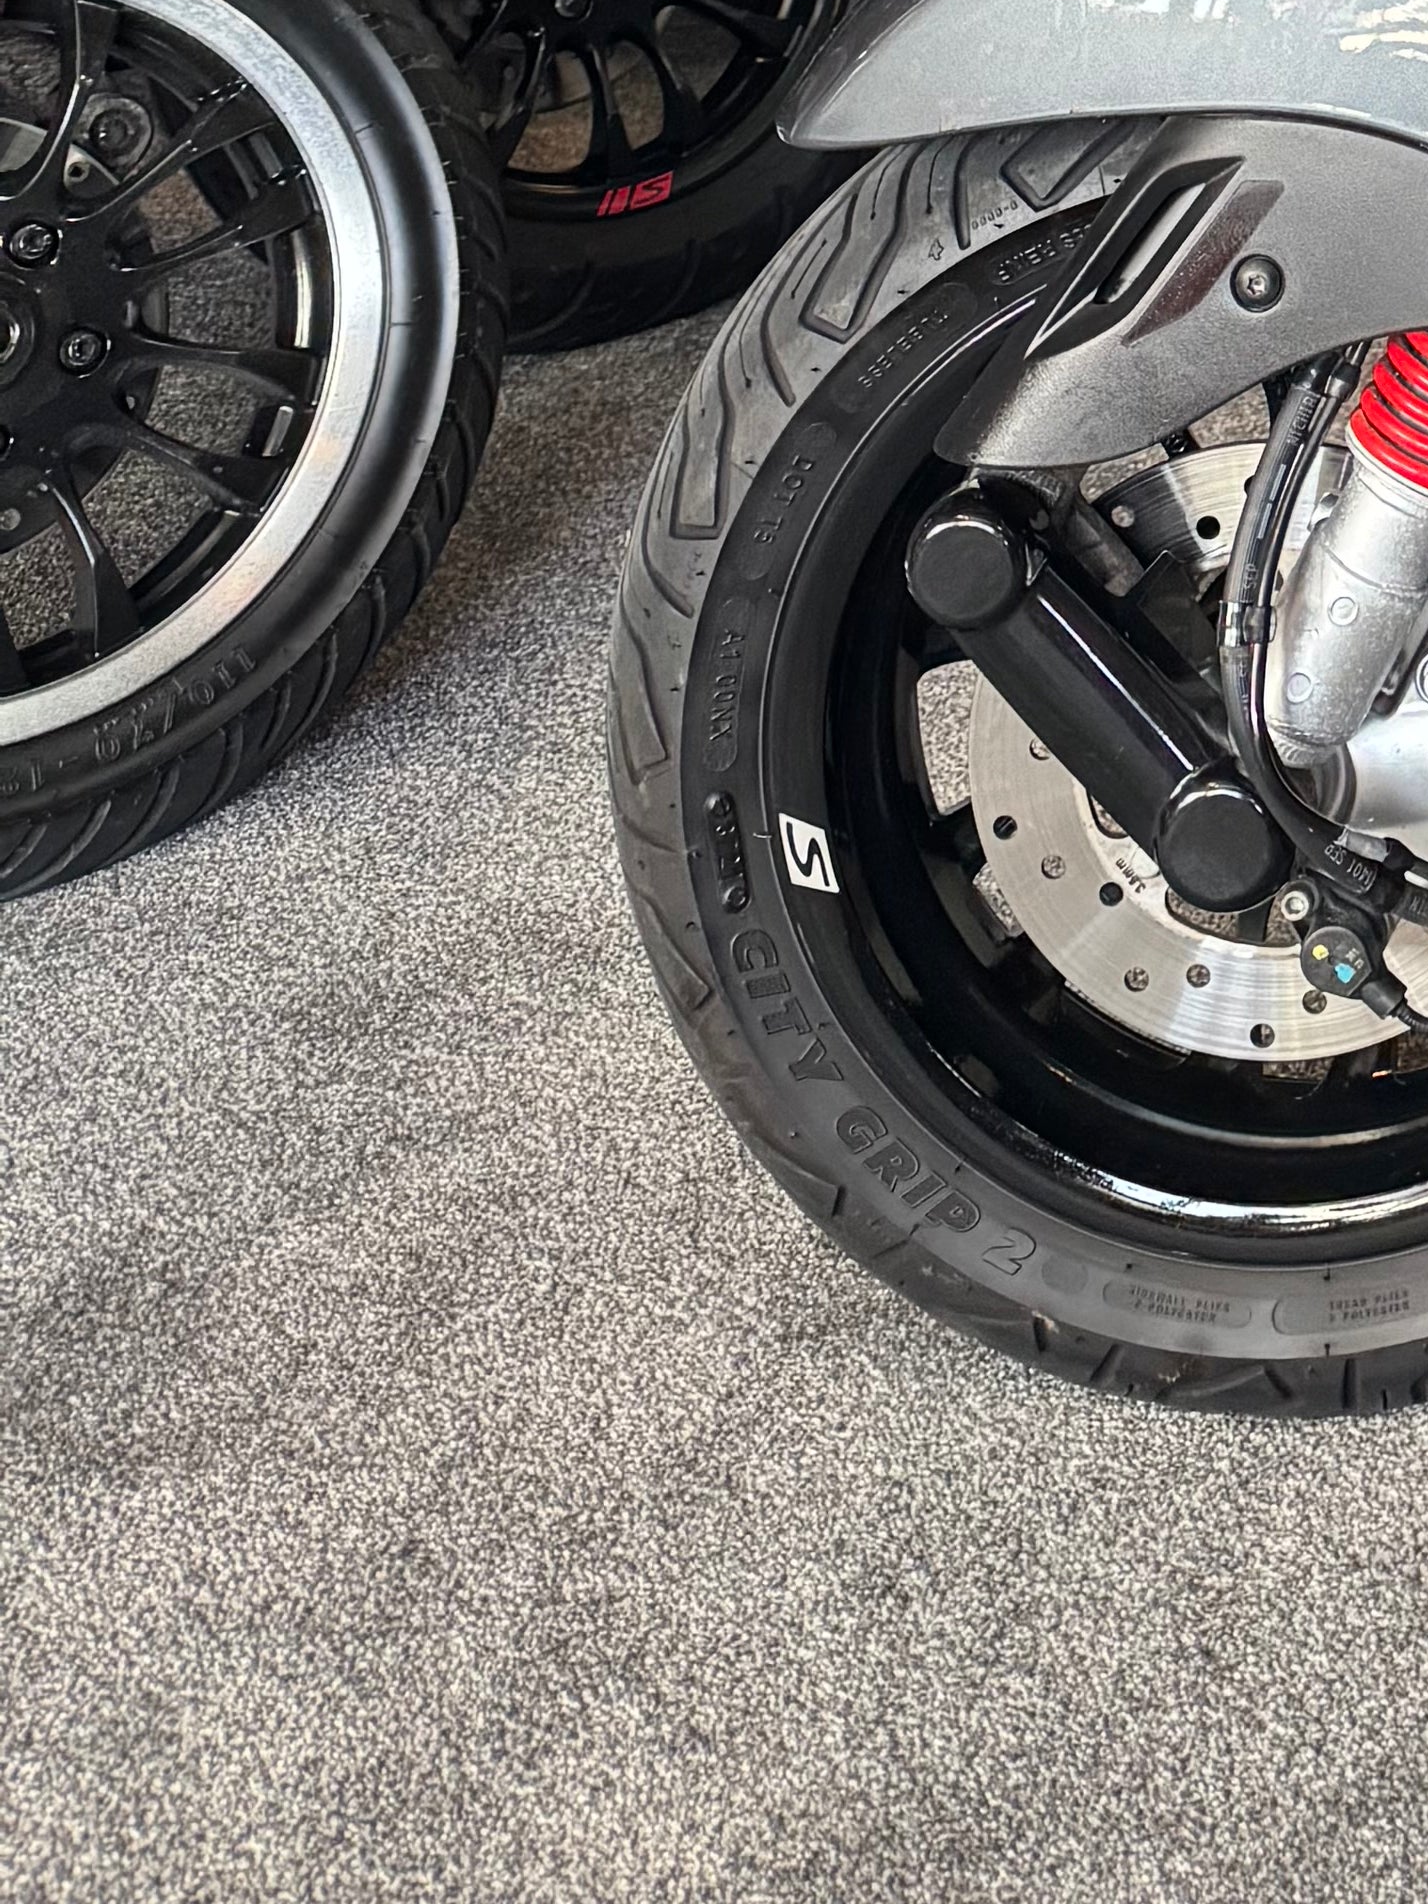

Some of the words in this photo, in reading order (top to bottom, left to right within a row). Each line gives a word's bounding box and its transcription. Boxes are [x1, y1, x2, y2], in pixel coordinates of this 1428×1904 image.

[730, 928, 845, 1083] CITY
[835, 1104, 982, 1234] GRIP
[982, 1226, 1037, 1276] 2
